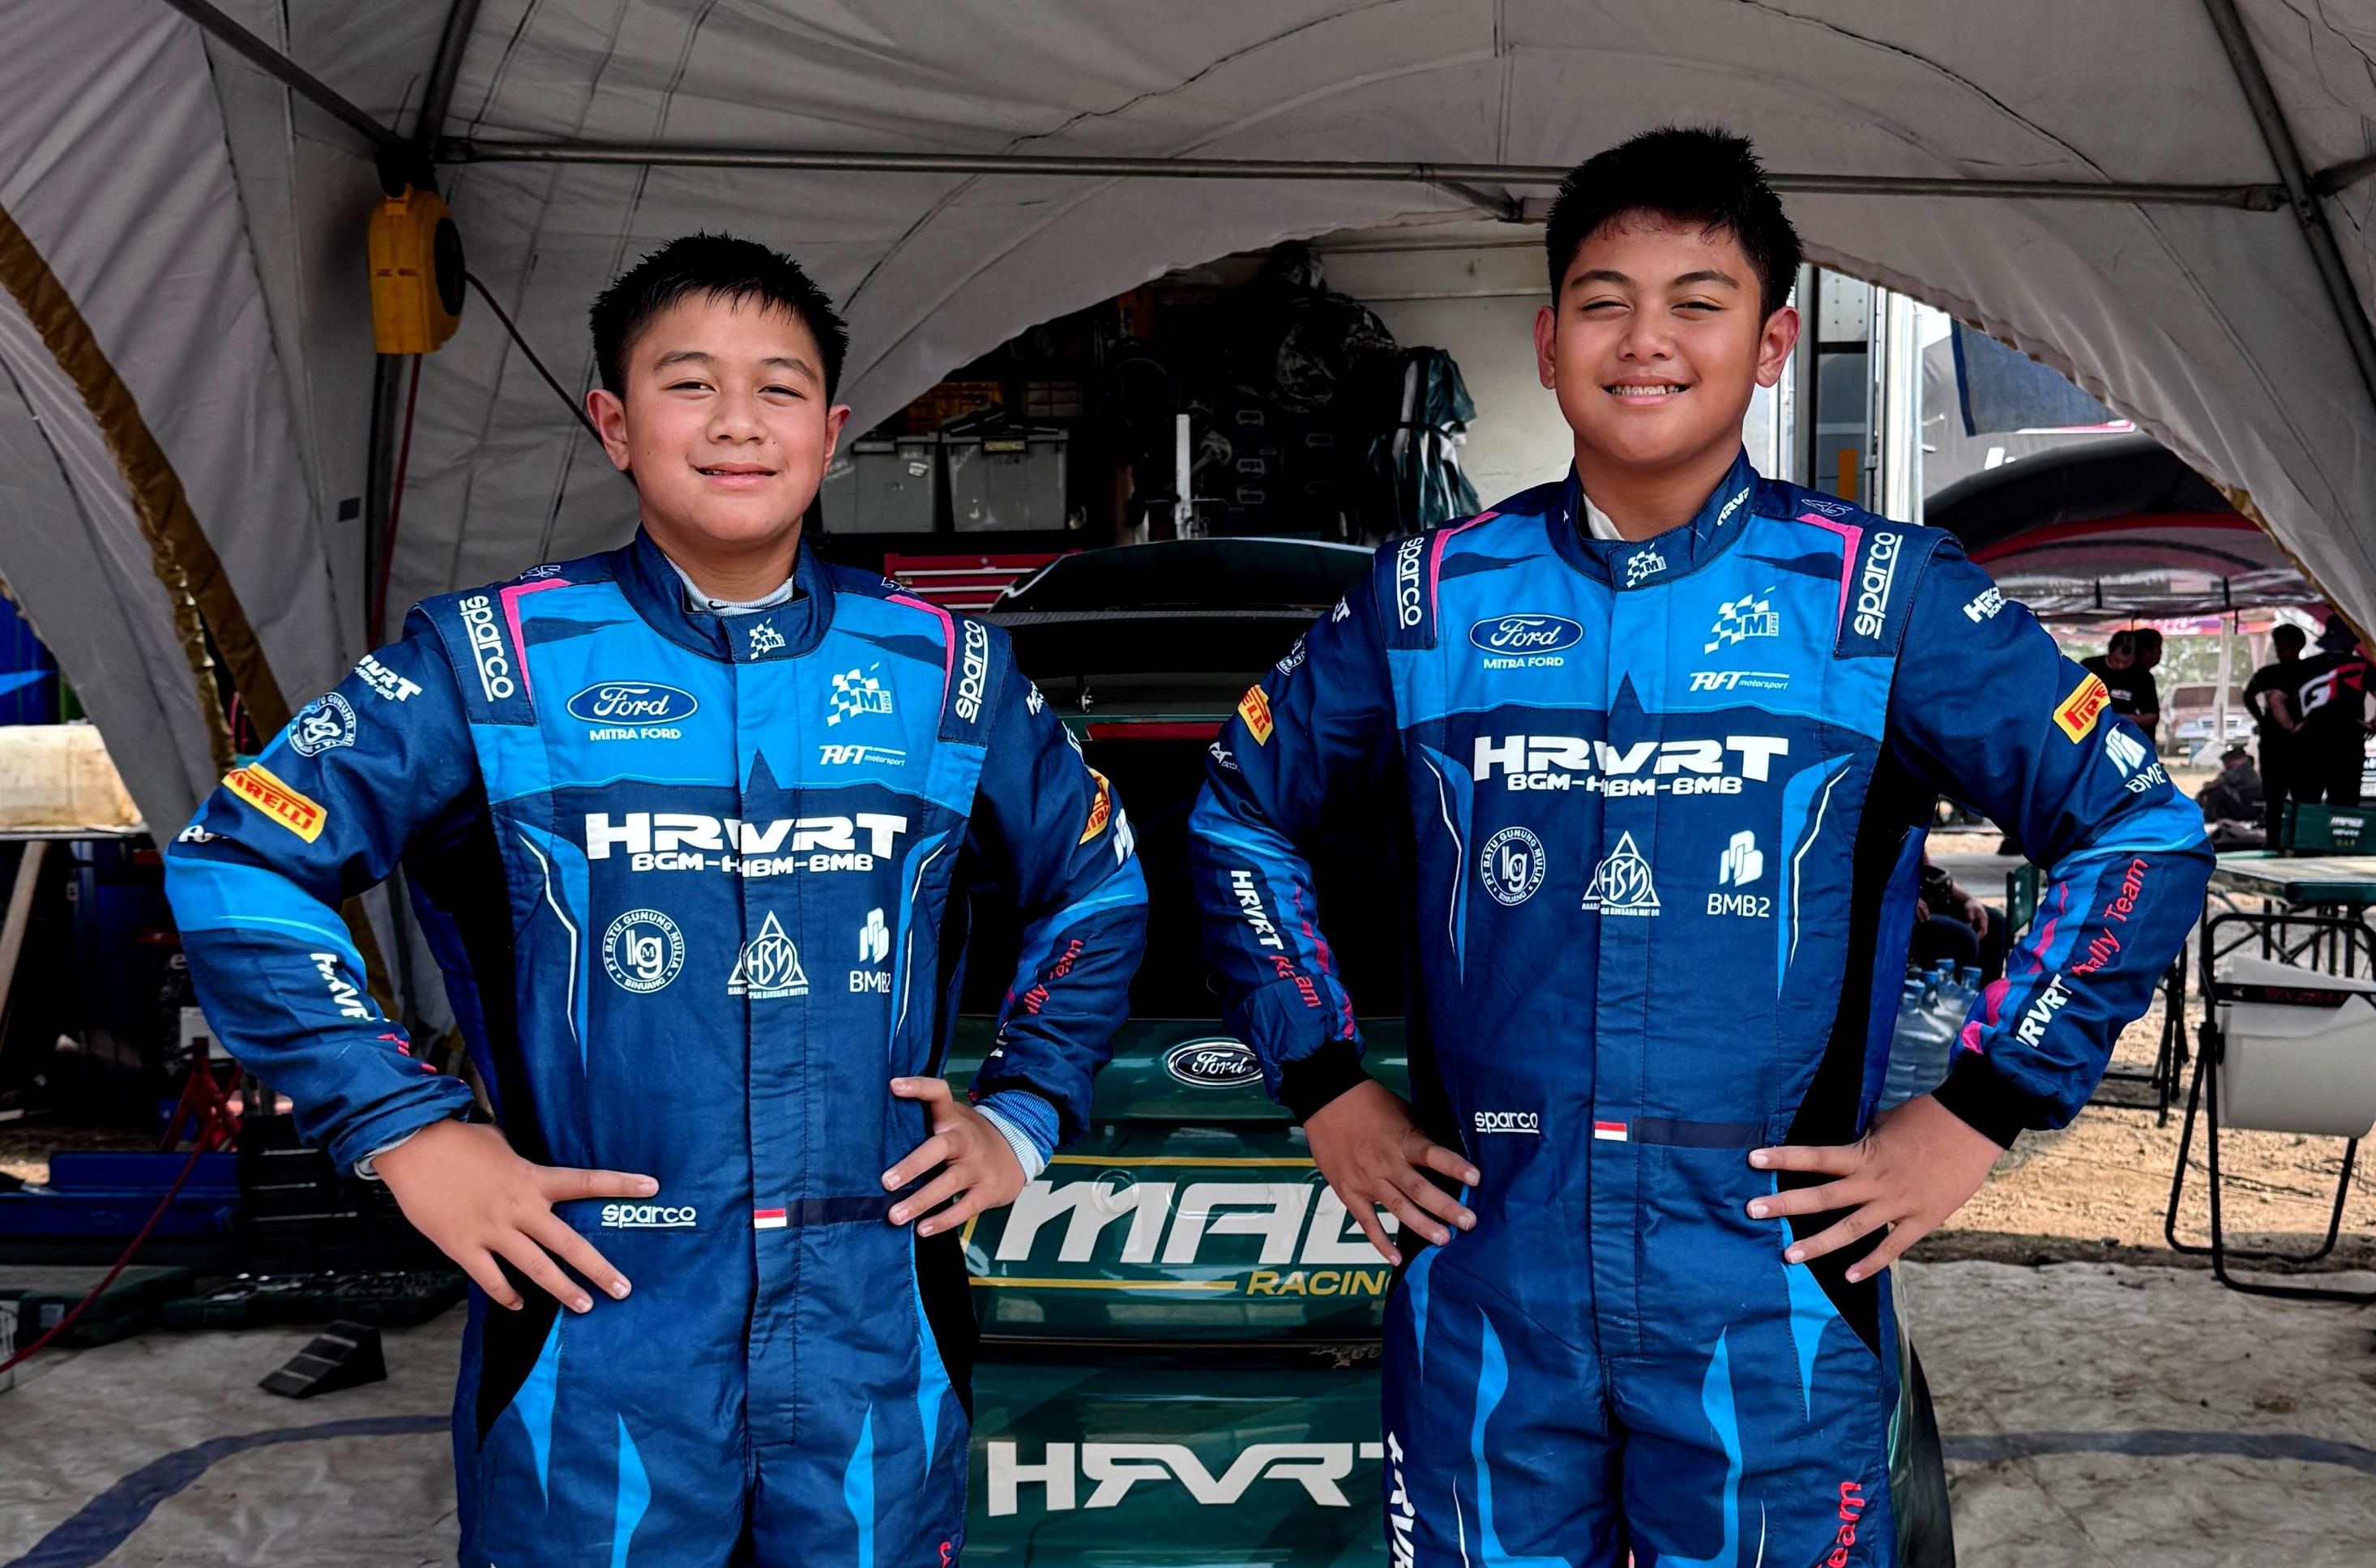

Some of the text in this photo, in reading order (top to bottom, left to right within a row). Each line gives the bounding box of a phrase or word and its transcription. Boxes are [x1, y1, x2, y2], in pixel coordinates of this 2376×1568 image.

[1396, 536, 1425, 630] sparco
[1854, 532, 1903, 640] sparco
[1489, 617, 1562, 647] Ford
[459, 596, 514, 703] sparco
[1483, 657, 1564, 669] MITRA FORD
[955, 620, 989, 724] sparco
[1738, 679, 1789, 690] motorsport
[593, 686, 669, 716] Ford
[590, 728, 682, 741] MITRA FORD
[863, 754, 906, 767] motorsport
[1473, 734, 1789, 782] HRVRT
[585, 812, 908, 861] HRVRT
[1532, 848, 1544, 883] MULIA
[1706, 892, 1771, 918] BMB2
[2104, 857, 2149, 924] Team
[1230, 869, 1284, 951] HRVRT
[605, 922, 622, 953] BATU
[622, 912, 673, 931] GUNUNG
[670, 930, 682, 969] MULIA
[624, 976, 666, 990] BINUANG
[1191, 1050, 1249, 1076] Ford
[1474, 1109, 1540, 1134] sparco
[600, 1203, 697, 1228] sparco
[1246, 1270, 1391, 1297] RACIN
